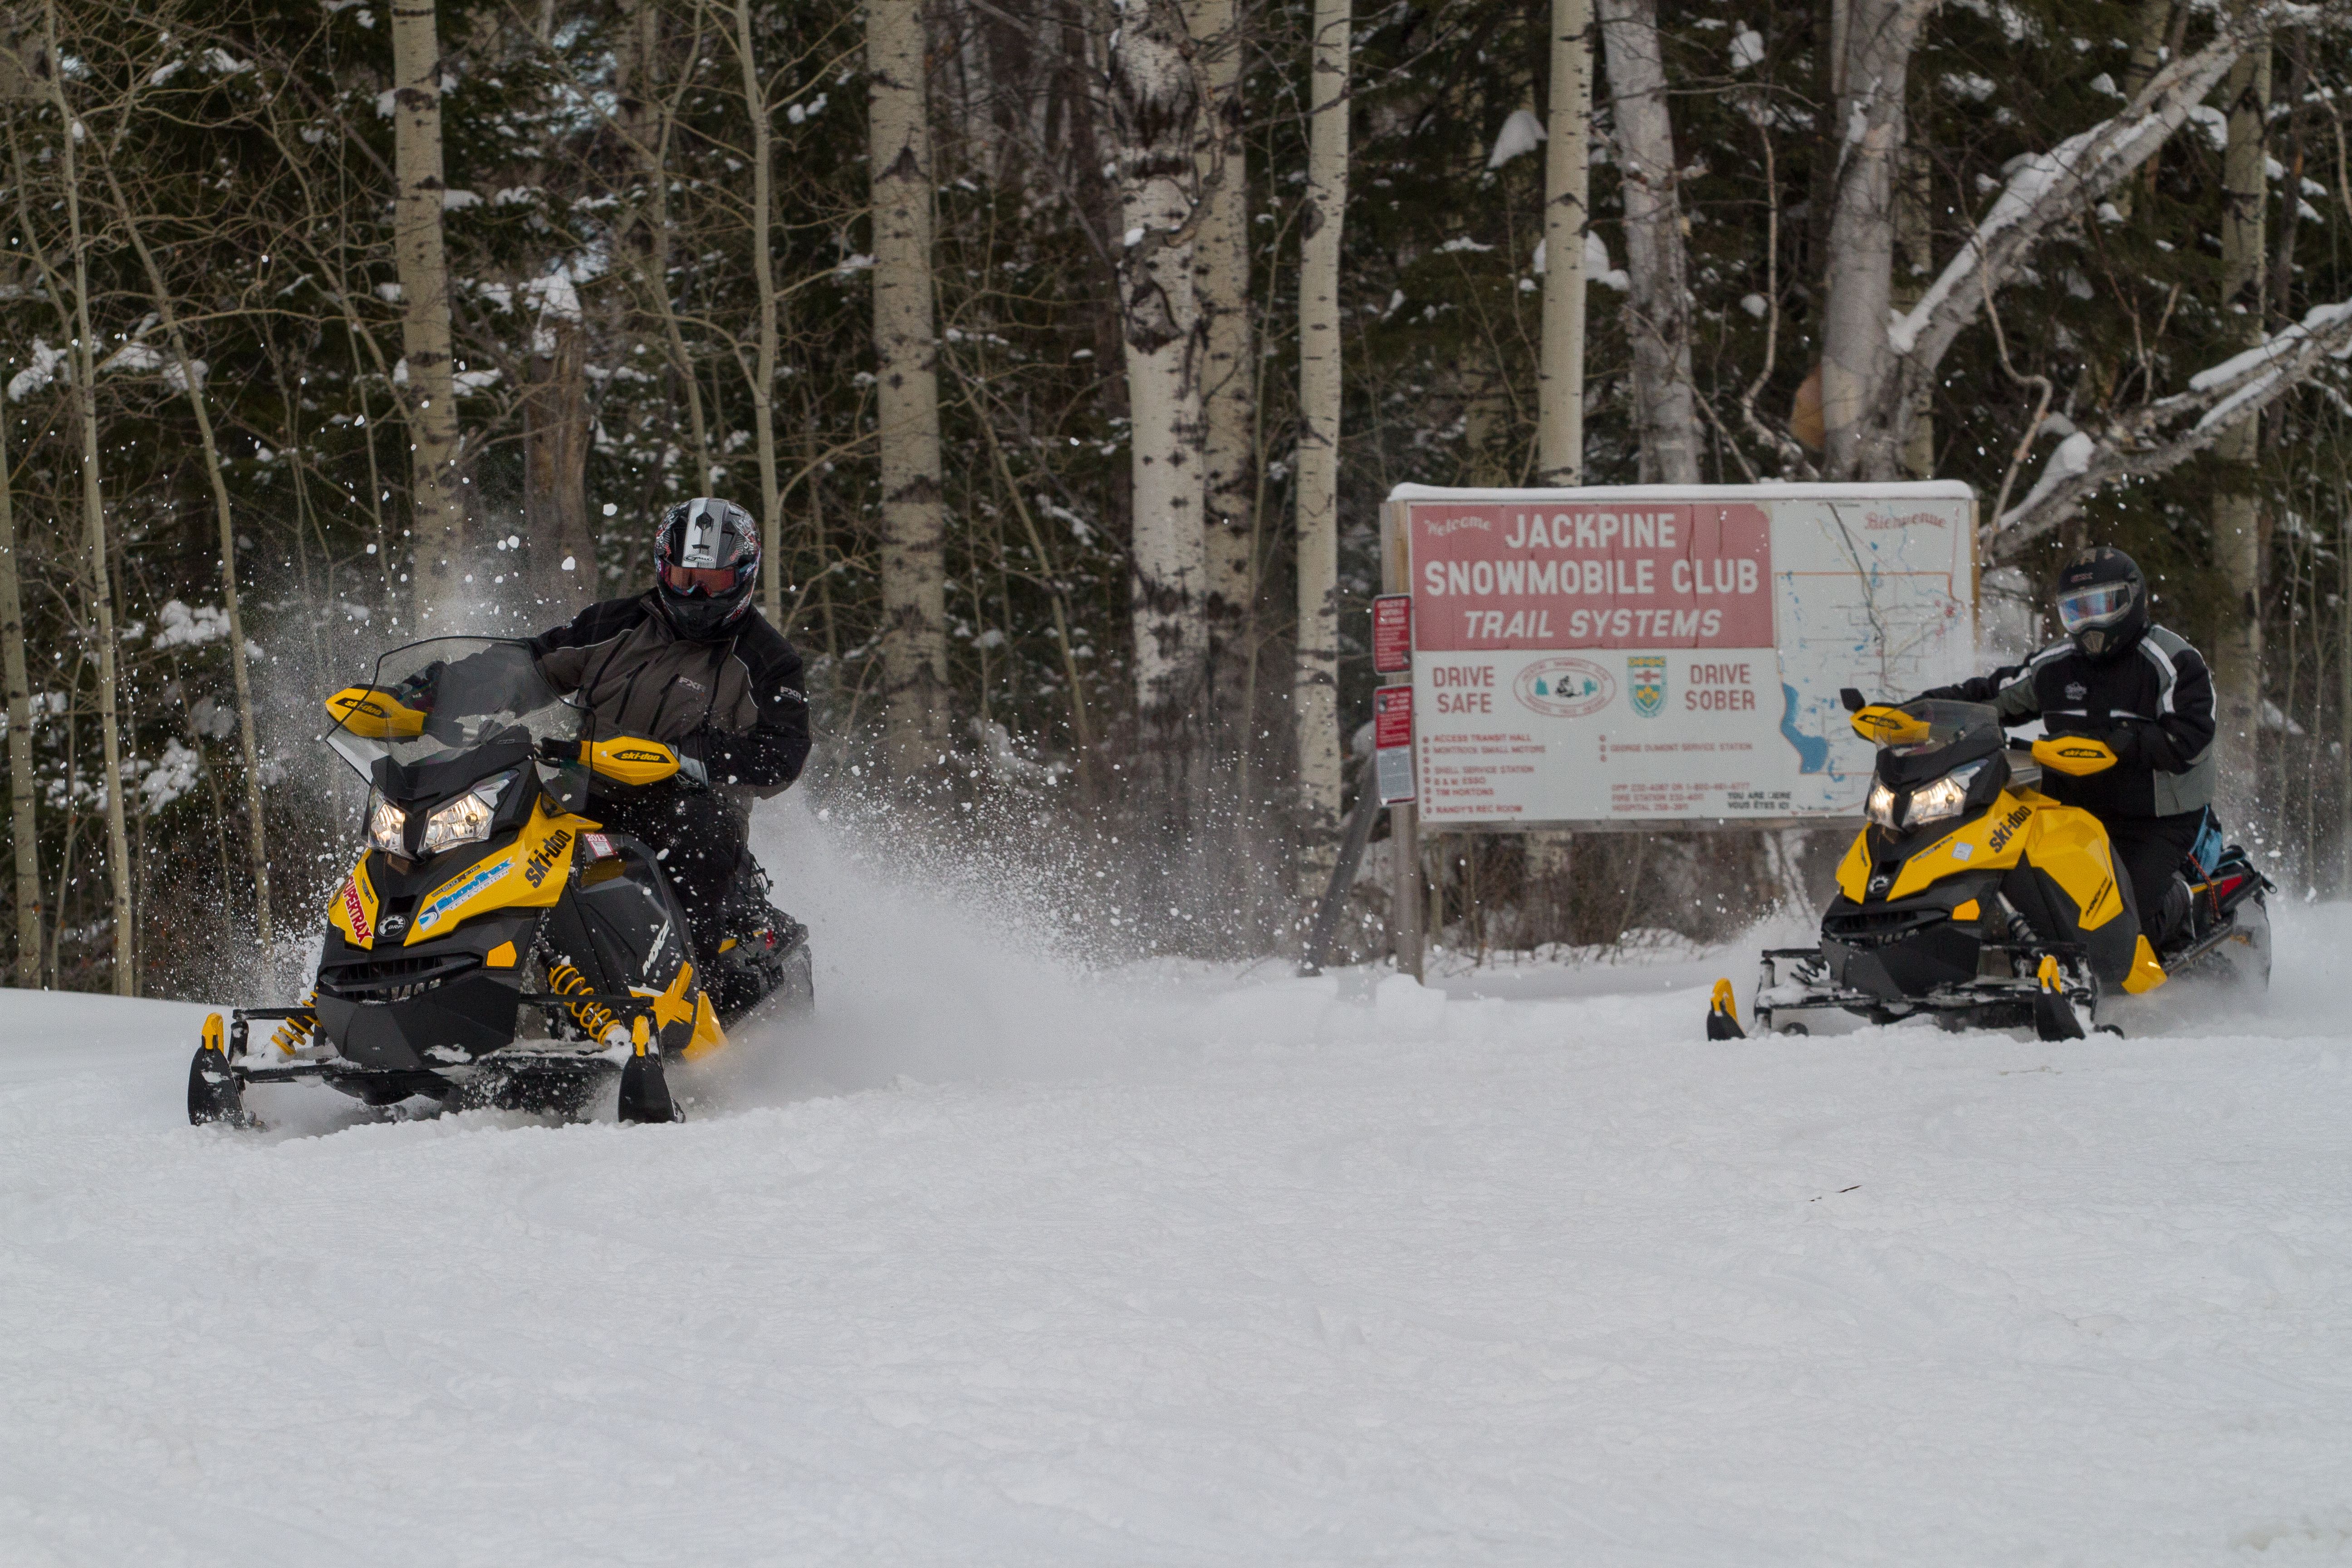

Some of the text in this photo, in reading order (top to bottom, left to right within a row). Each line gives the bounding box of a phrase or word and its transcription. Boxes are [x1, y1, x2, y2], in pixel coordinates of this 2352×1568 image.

[1424, 516, 1491, 537] Welcome
[1506, 513, 1676, 549] JACKPINE
[1425, 559, 1759, 596] SNOWMOBILE CLUB
[1465, 609, 1723, 638] TRAIL SYSTEMS
[679, 676, 706, 692] FXR
[1433, 666, 1494, 687] DRIVE
[1690, 664, 1751, 684] DRIVE
[780, 686, 802, 700] FXR
[1437, 693, 1492, 714] SAFE
[1685, 690, 1755, 710] SOBER
[621, 752, 660, 761] ski-doo
[1989, 806, 2032, 853] ski-doo
[525, 829, 572, 888] ski-doo
[450, 870, 509, 909] TELEVISION
[343, 875, 374, 946] SUPERTRAX
